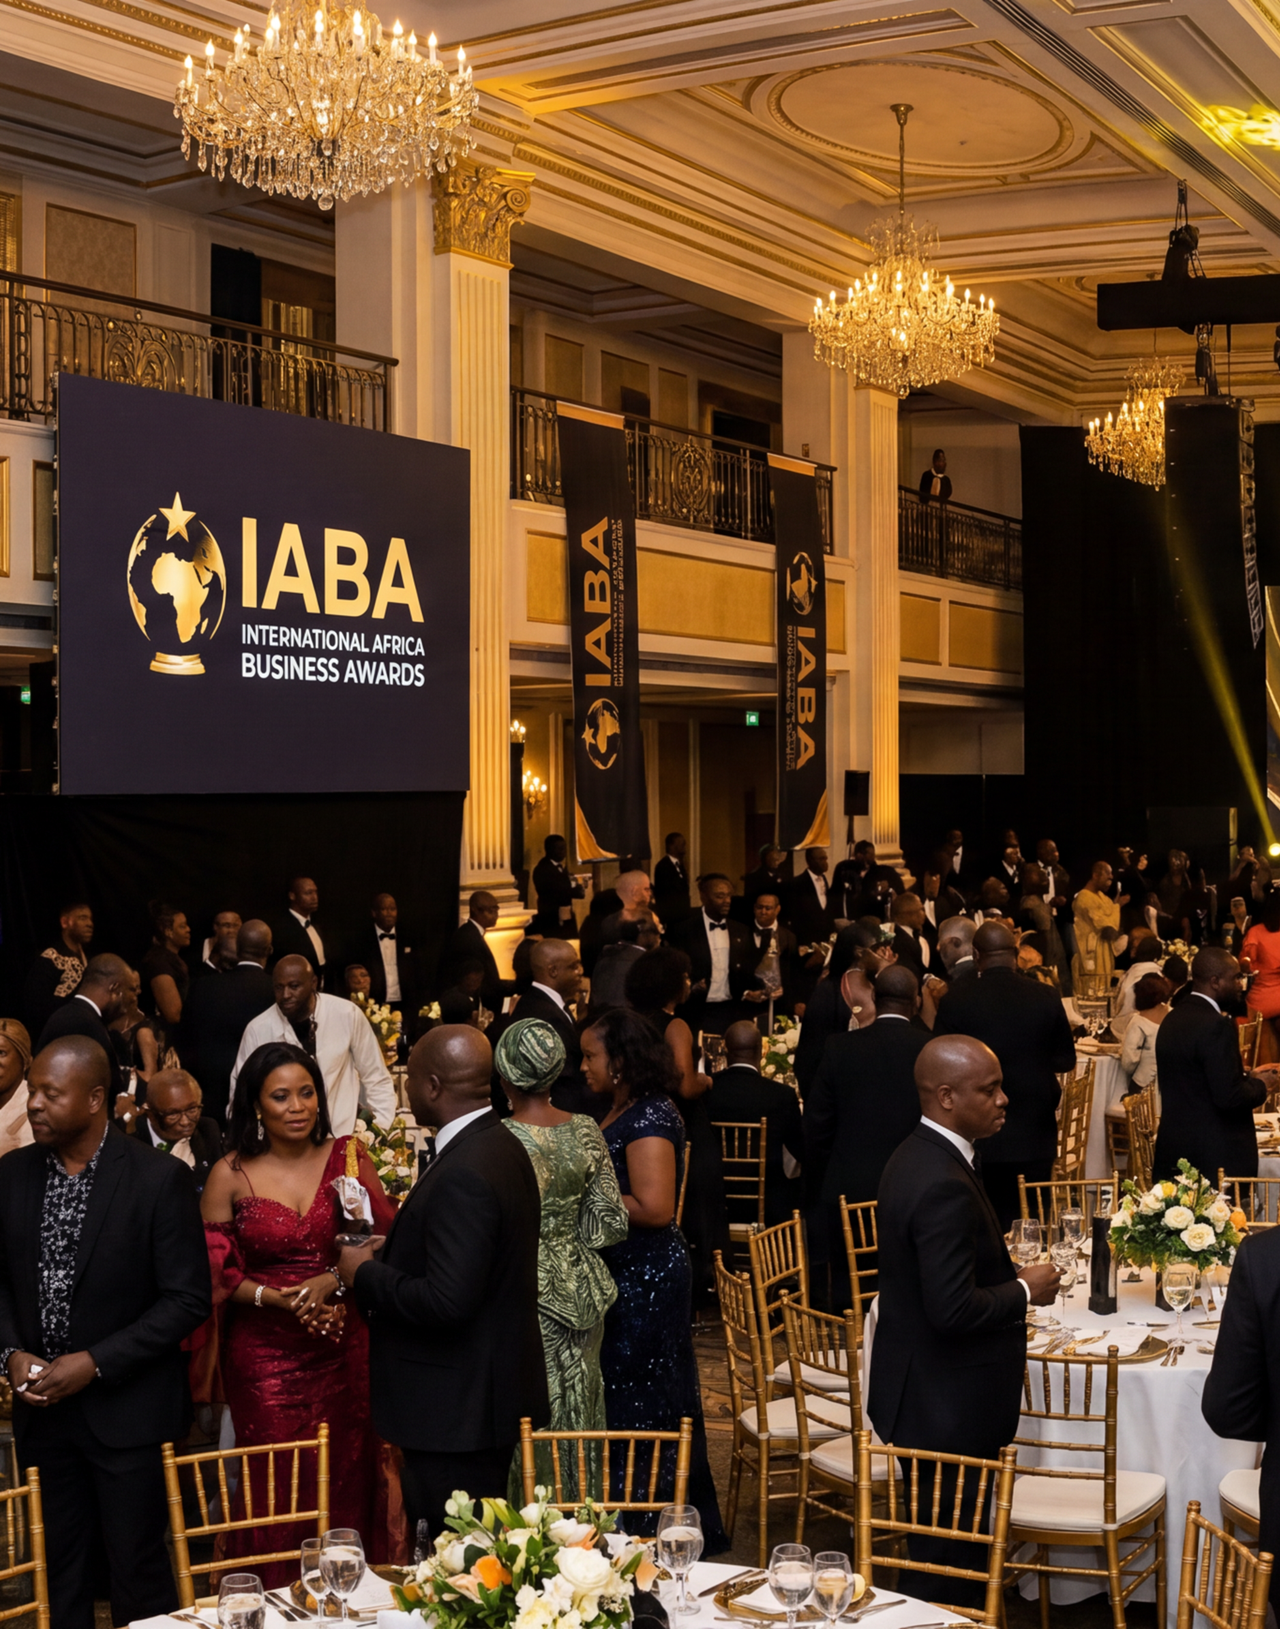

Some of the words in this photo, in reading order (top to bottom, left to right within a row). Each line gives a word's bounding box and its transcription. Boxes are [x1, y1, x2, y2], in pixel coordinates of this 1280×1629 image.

[241, 516, 425, 623] IABA
[581, 516, 612, 687] IABA
[241, 623, 370, 653] INTERNATIONAL
[372, 633, 425, 656] AFRICA
[241, 652, 340, 683] BUSINESS
[343, 659, 426, 687] AWARDS
[796, 626, 816, 771] IABA
